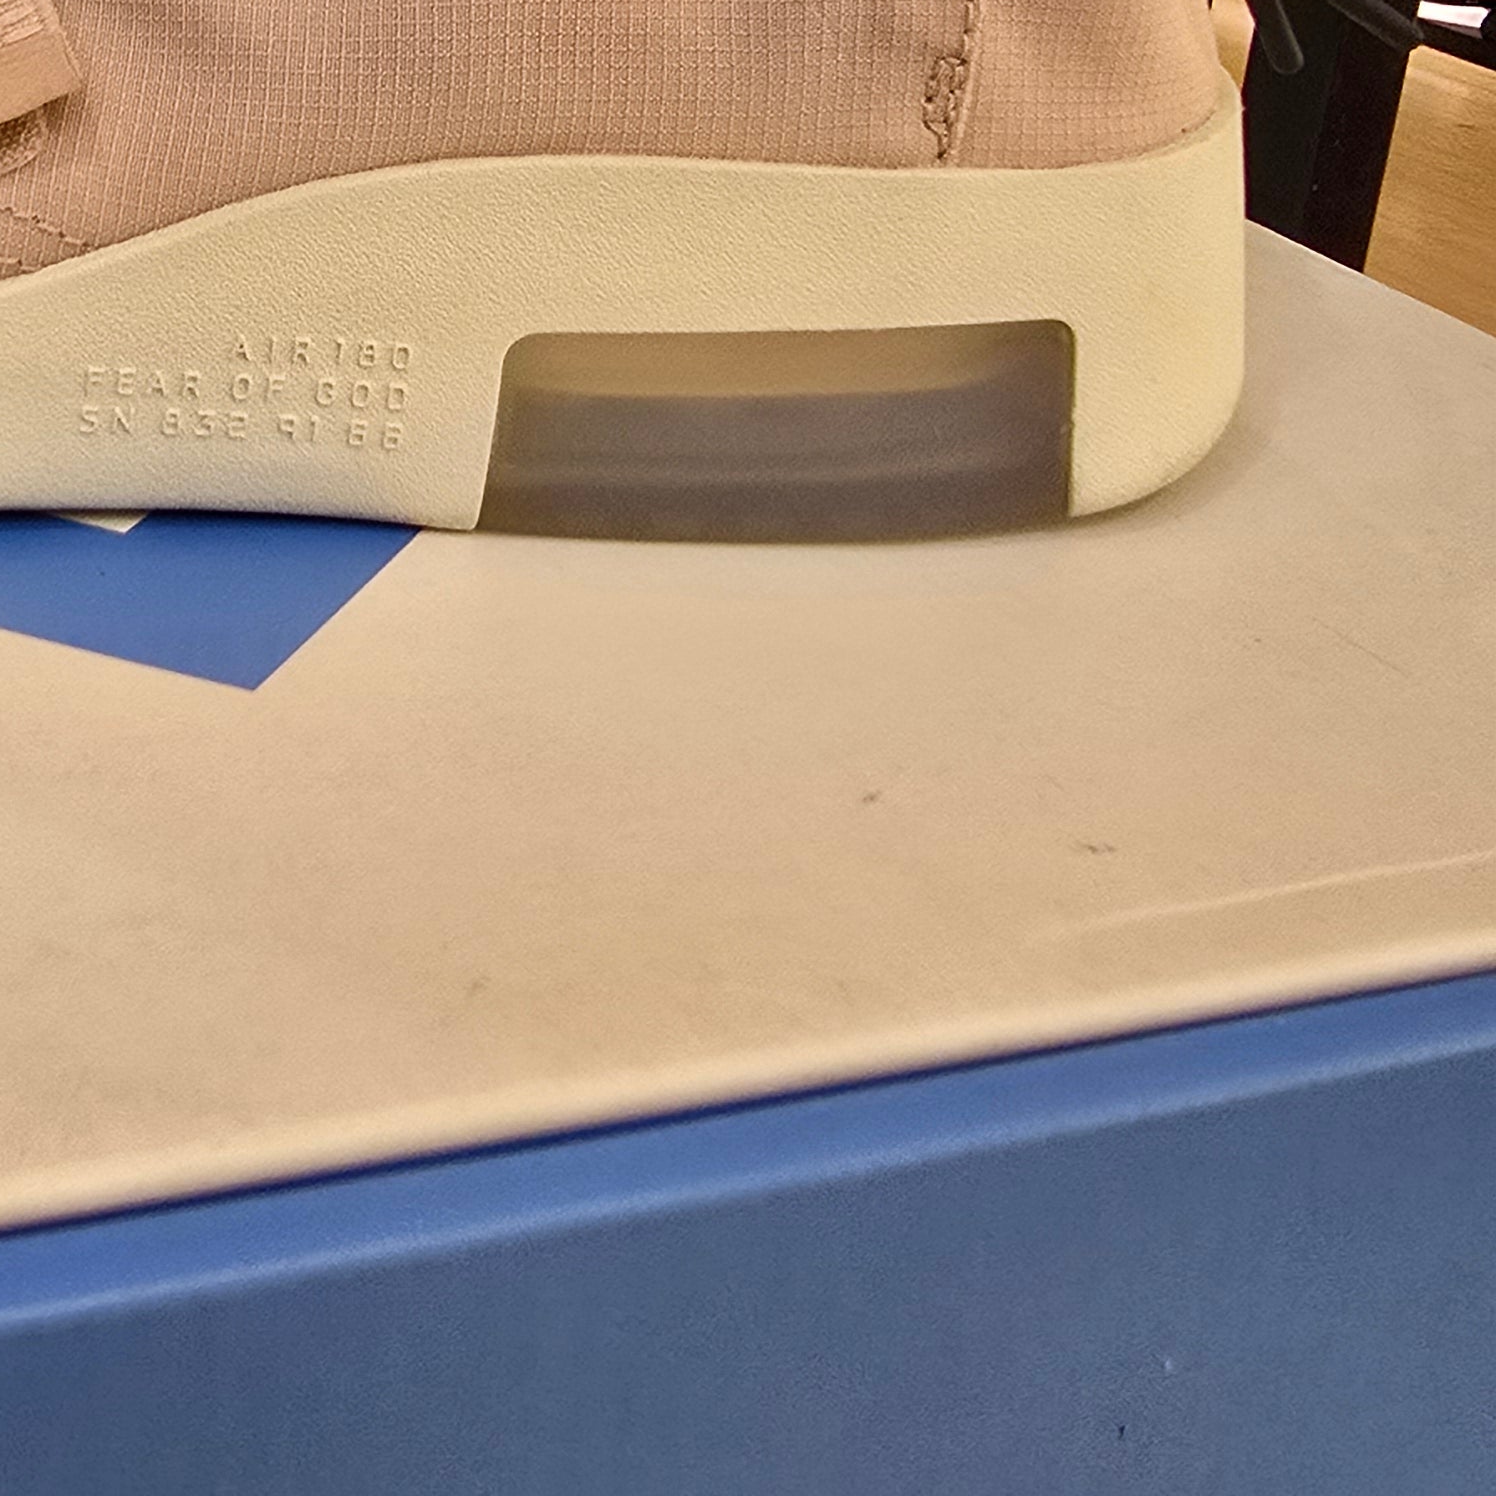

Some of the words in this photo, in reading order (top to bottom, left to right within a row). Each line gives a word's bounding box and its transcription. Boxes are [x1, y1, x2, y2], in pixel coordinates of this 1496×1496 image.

[235, 335, 312, 365] AIR
[333, 338, 411, 370] 180
[82, 366, 202, 399] FEAR
[231, 372, 287, 401] OF
[315, 376, 406, 411] GOD
[78, 404, 137, 436] SN
